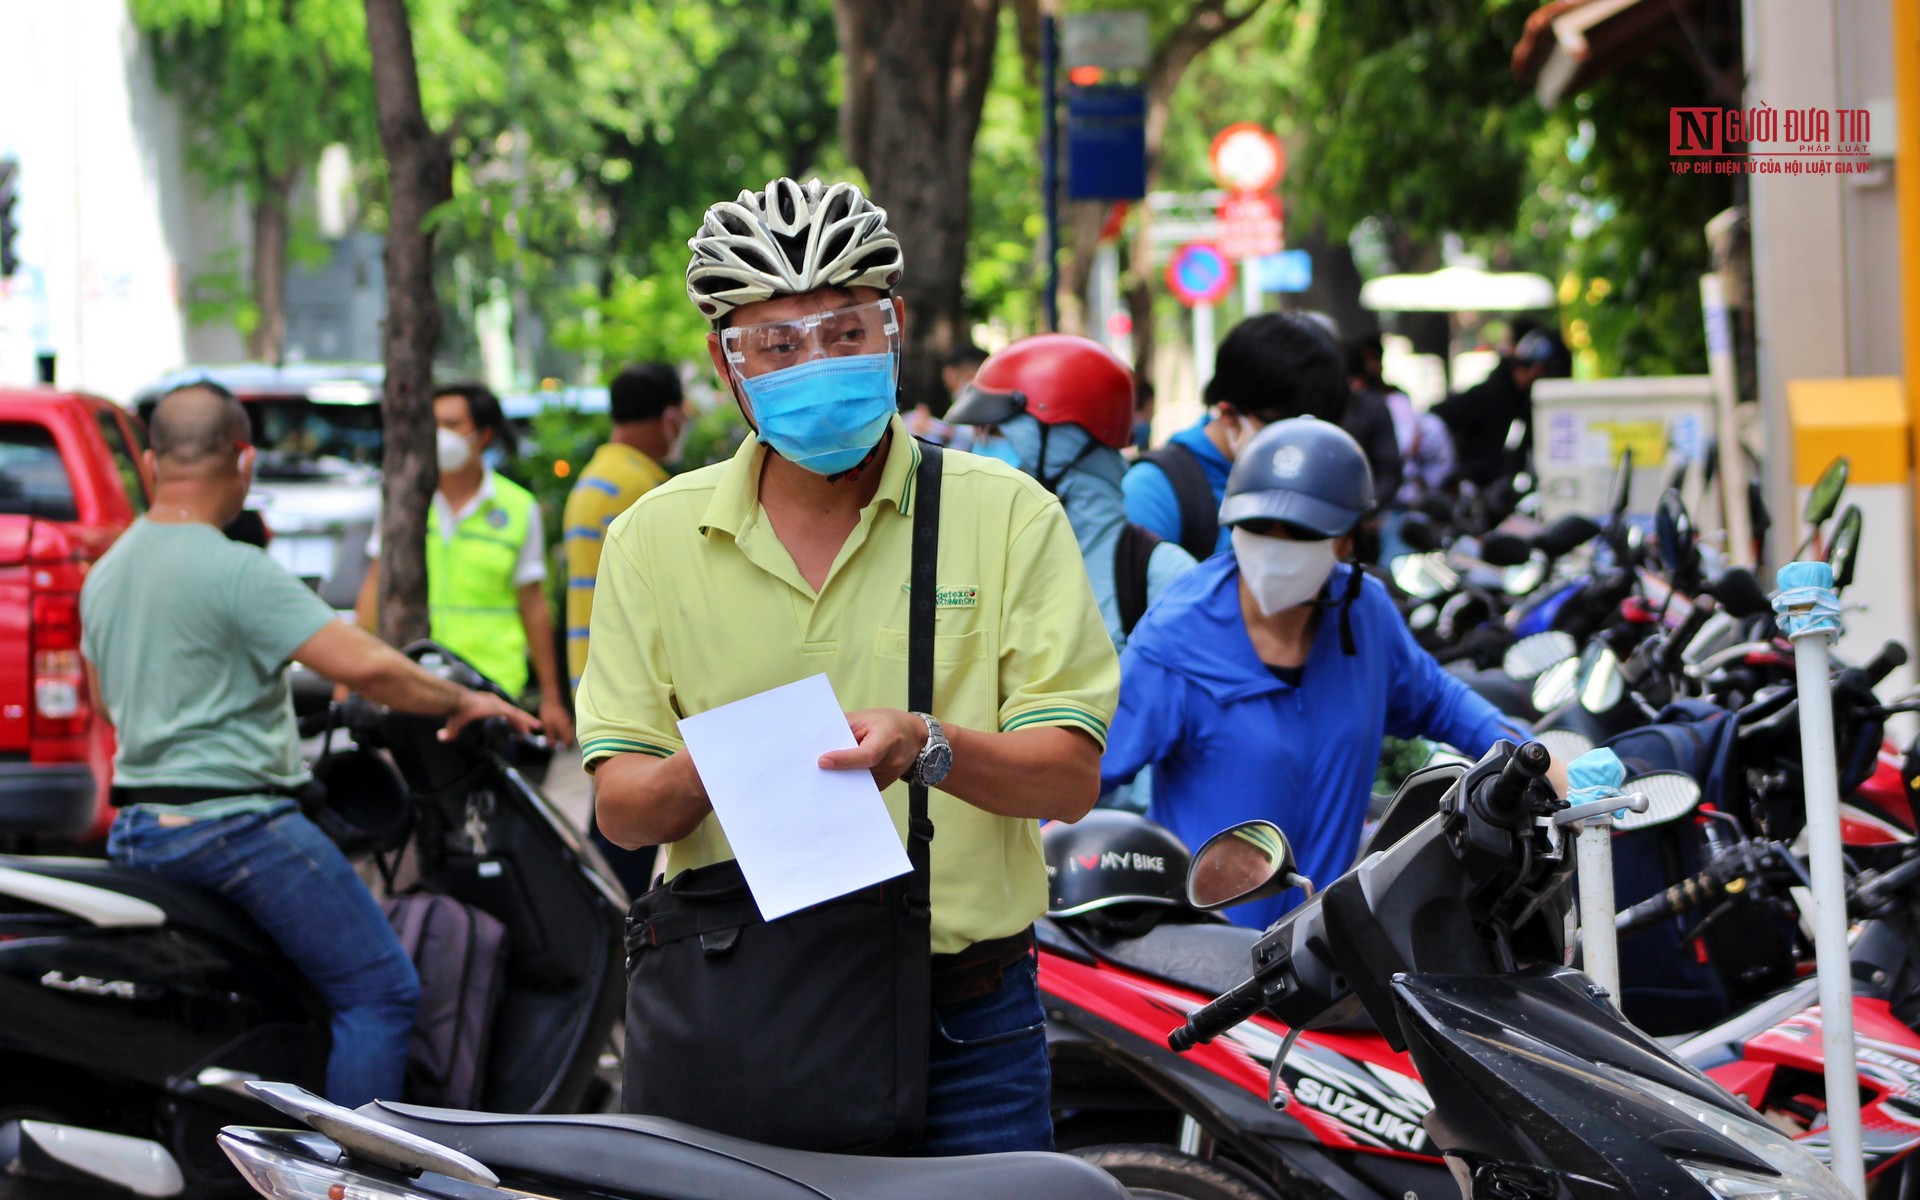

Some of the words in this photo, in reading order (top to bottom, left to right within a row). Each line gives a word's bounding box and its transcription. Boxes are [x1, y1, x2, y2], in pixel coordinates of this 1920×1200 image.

[1100, 851, 1130, 871] MY
[1132, 852, 1166, 873] BIKE
[1294, 1077, 1427, 1151] SUZUKI
